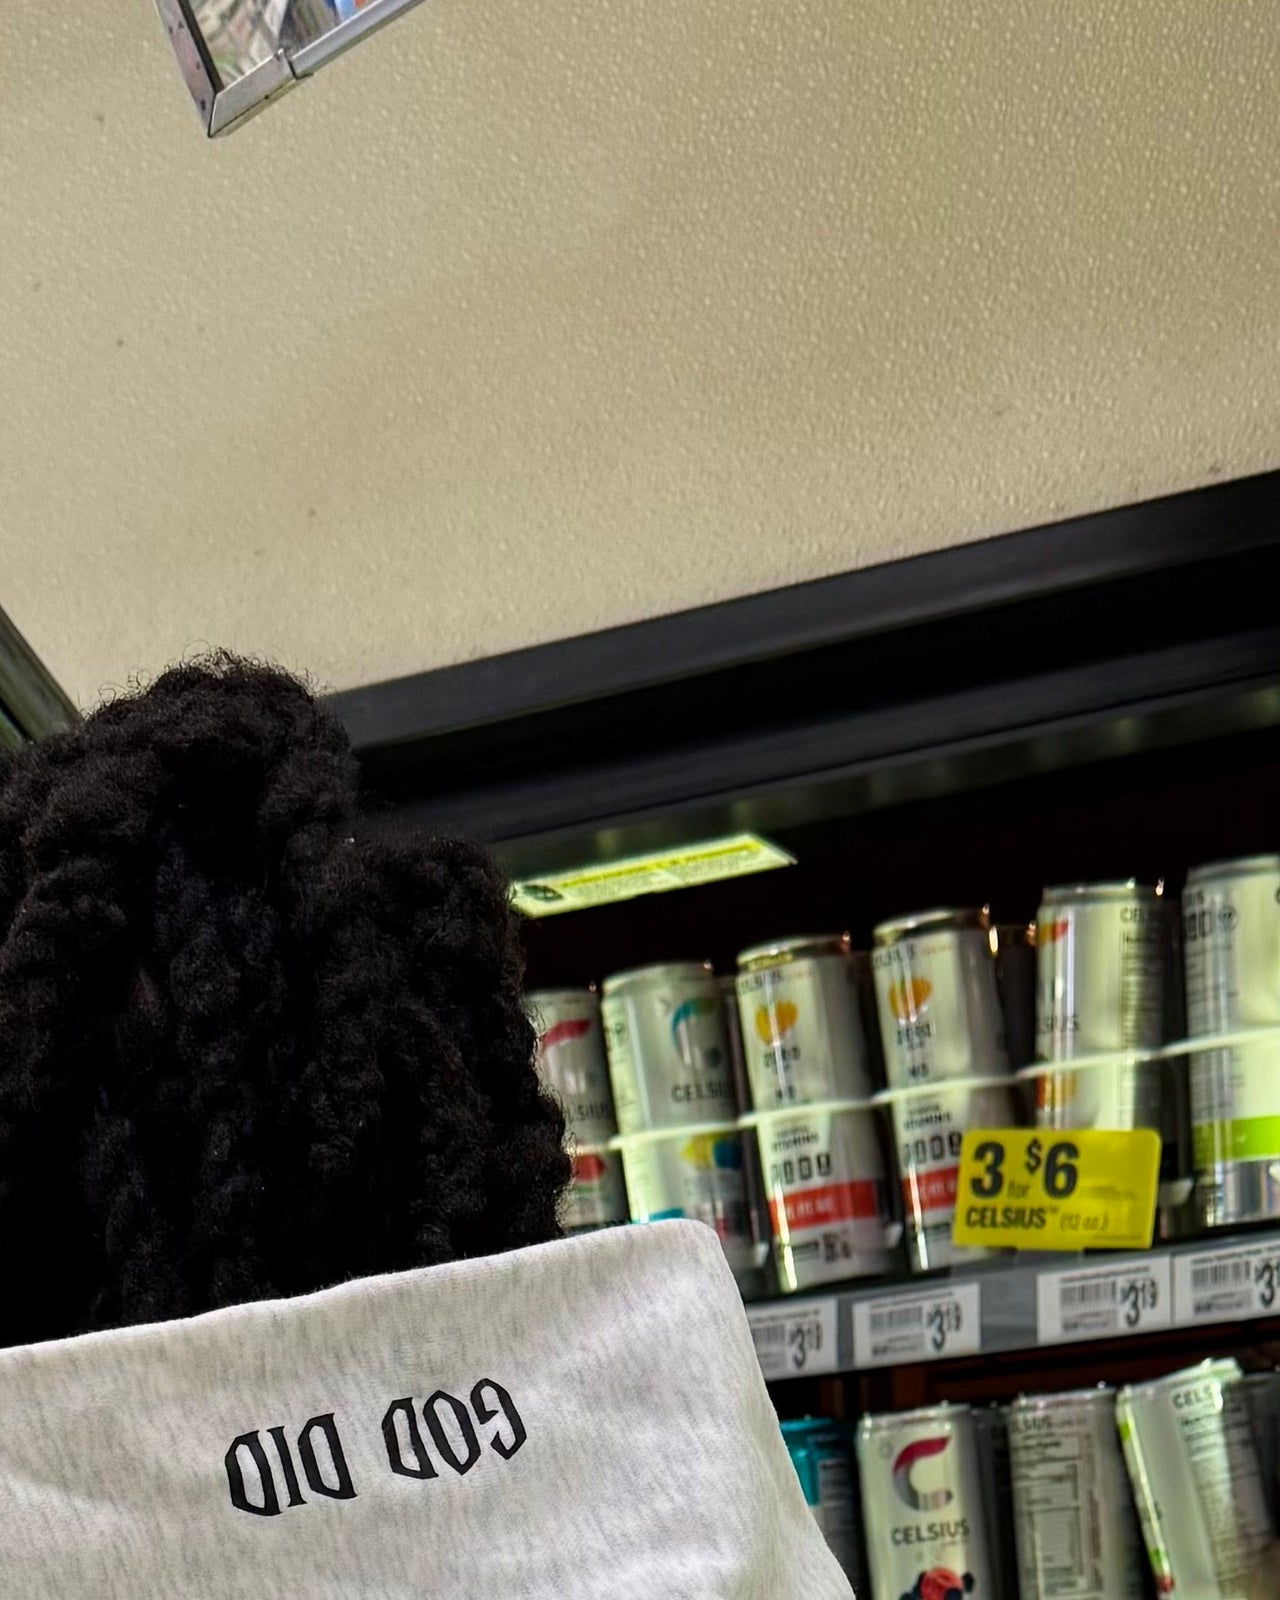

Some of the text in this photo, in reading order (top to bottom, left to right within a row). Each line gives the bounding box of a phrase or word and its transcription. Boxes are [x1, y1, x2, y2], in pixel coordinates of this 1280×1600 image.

[971, 1141, 1005, 1198] 3
[1024, 1138, 1079, 1198] $6
[224, 1377, 528, 1517] GOD DID
[891, 1518, 971, 1547] CELSIUS
